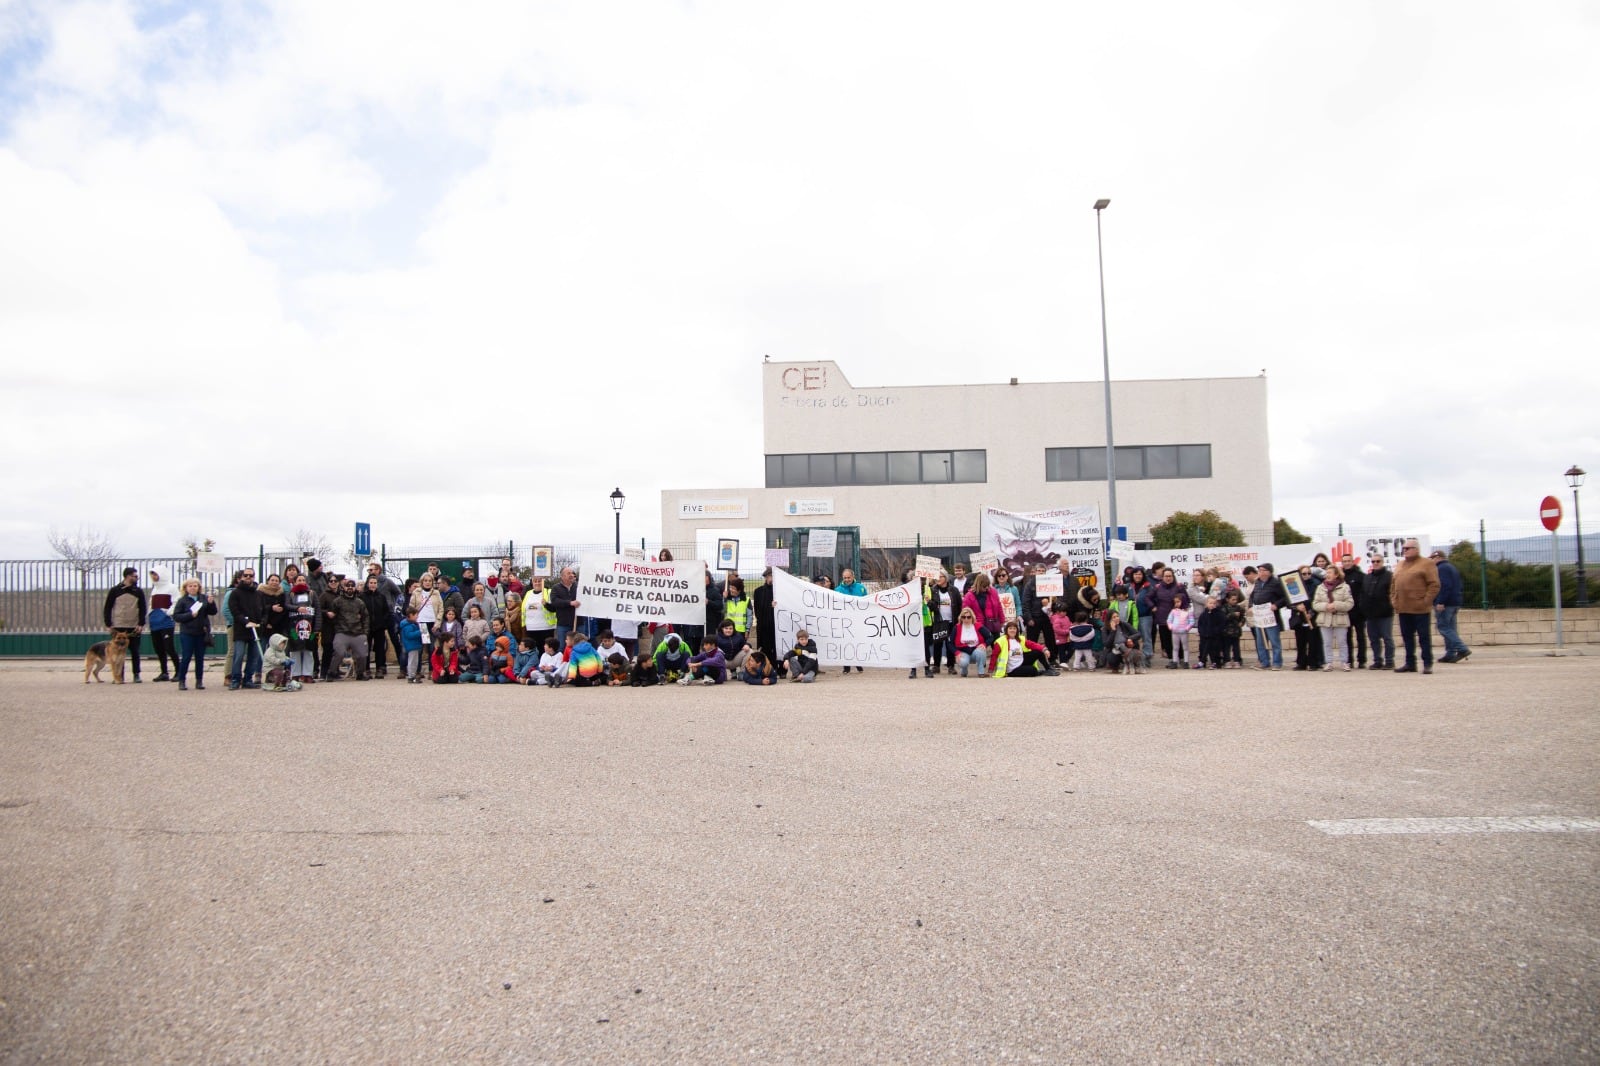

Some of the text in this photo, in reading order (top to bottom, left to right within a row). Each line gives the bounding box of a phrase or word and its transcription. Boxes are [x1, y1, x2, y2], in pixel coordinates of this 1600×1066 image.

[857, 395, 902, 407] Duer
[1366, 537, 1416, 558] STO
[1171, 555, 1188, 563] POR
[1195, 554, 1204, 562] EL
[595, 573, 689, 590] NO DESTRUYAS
[582, 585, 700, 604] NUESTRA CALIDAD
[802, 588, 905, 611] QUIERO STOP
[615, 603, 666, 616] DE VIDA
[776, 609, 921, 638] CRECER SANO
[826, 642, 891, 662] BIOGAS
